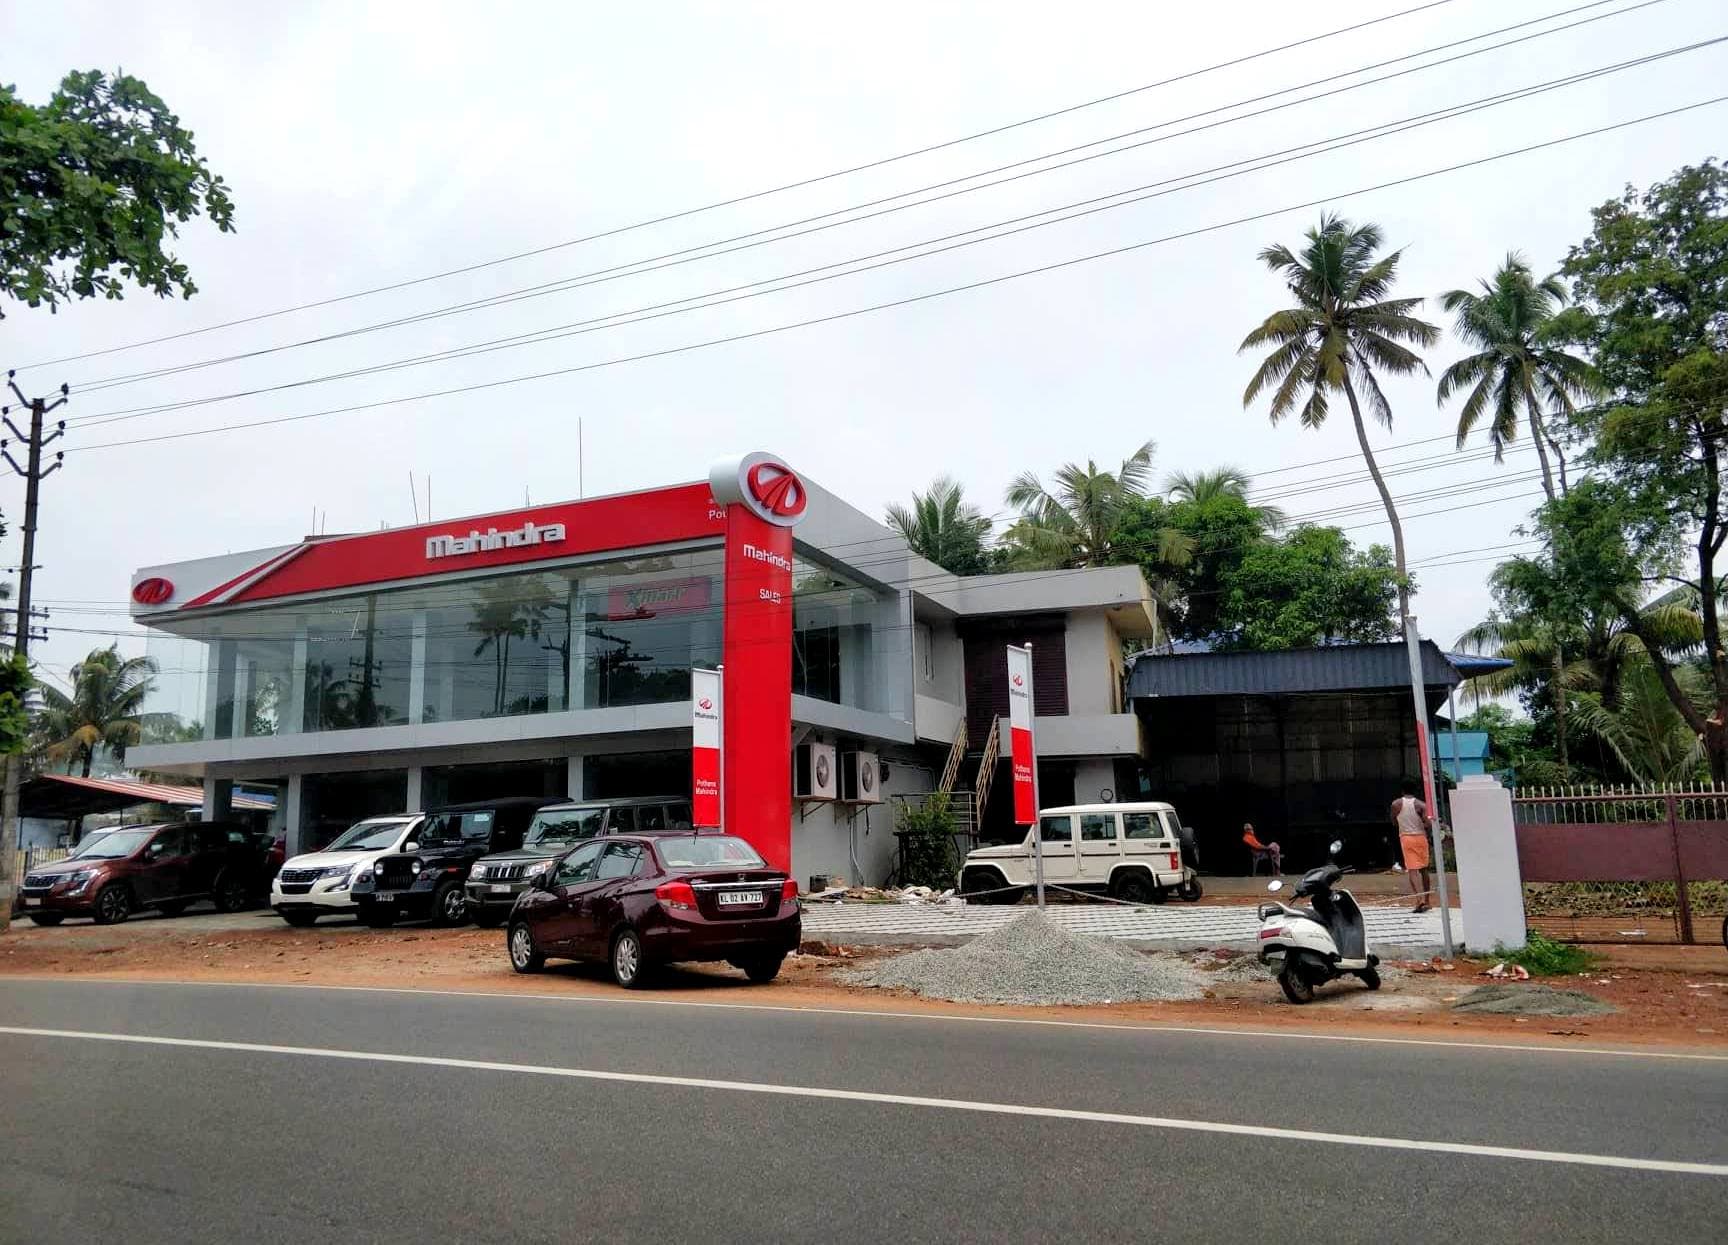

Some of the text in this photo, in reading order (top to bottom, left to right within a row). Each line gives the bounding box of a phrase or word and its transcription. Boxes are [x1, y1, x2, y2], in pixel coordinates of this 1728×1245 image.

[425, 521, 566, 559] Mahindra
[743, 543, 791, 571] Mahindra
[759, 588, 781, 605] SALES
